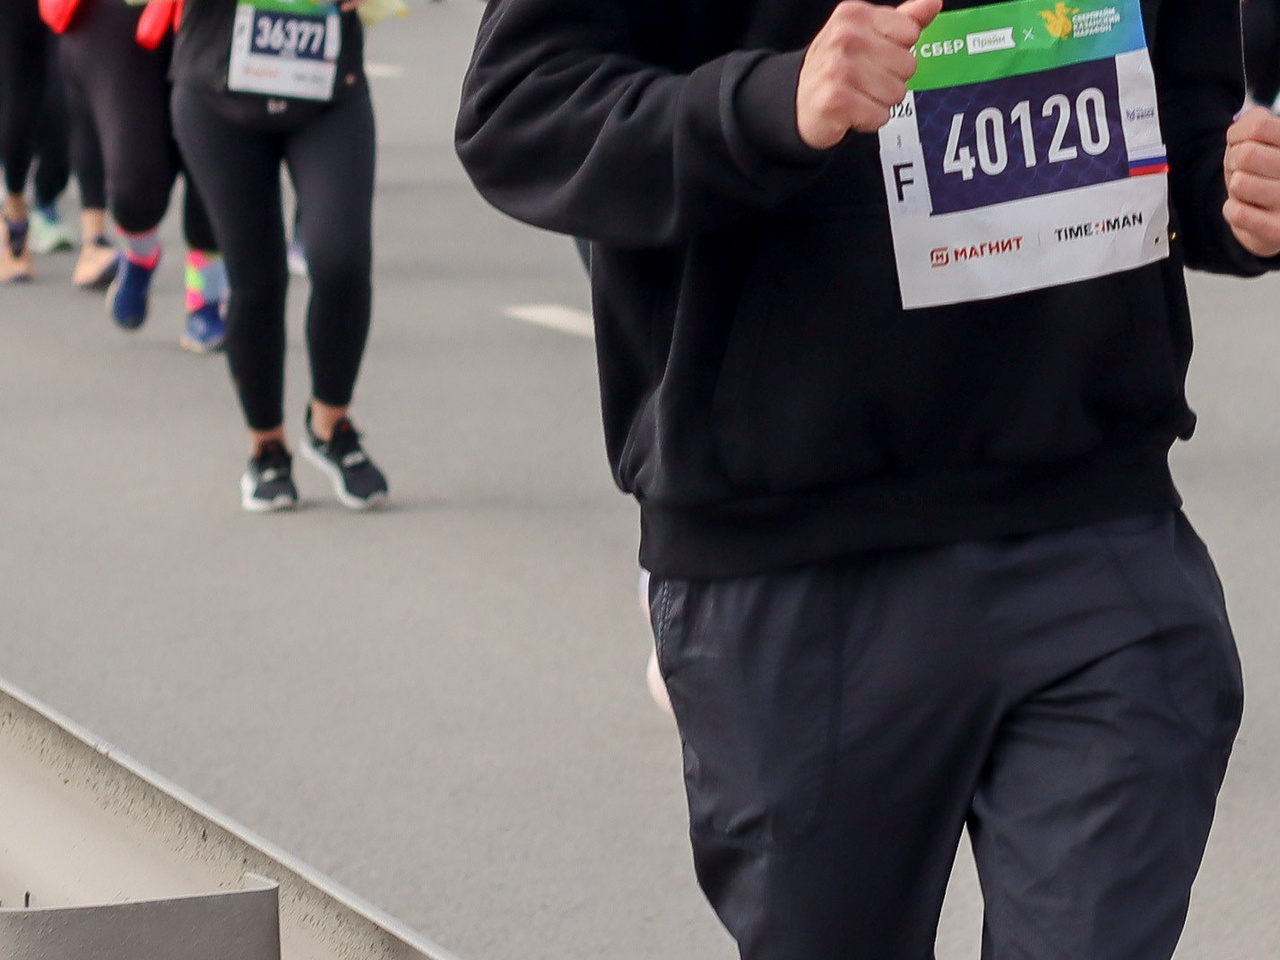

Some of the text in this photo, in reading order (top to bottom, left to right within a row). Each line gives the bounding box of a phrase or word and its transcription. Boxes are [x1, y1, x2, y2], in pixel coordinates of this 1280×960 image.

[255, 16, 325, 54] 36377
[920, 38, 965, 58] СБЕР
[943, 87, 1111, 181] 40120
[893, 162, 914, 202] F
[954, 236, 1023, 263] МАГНИТ
